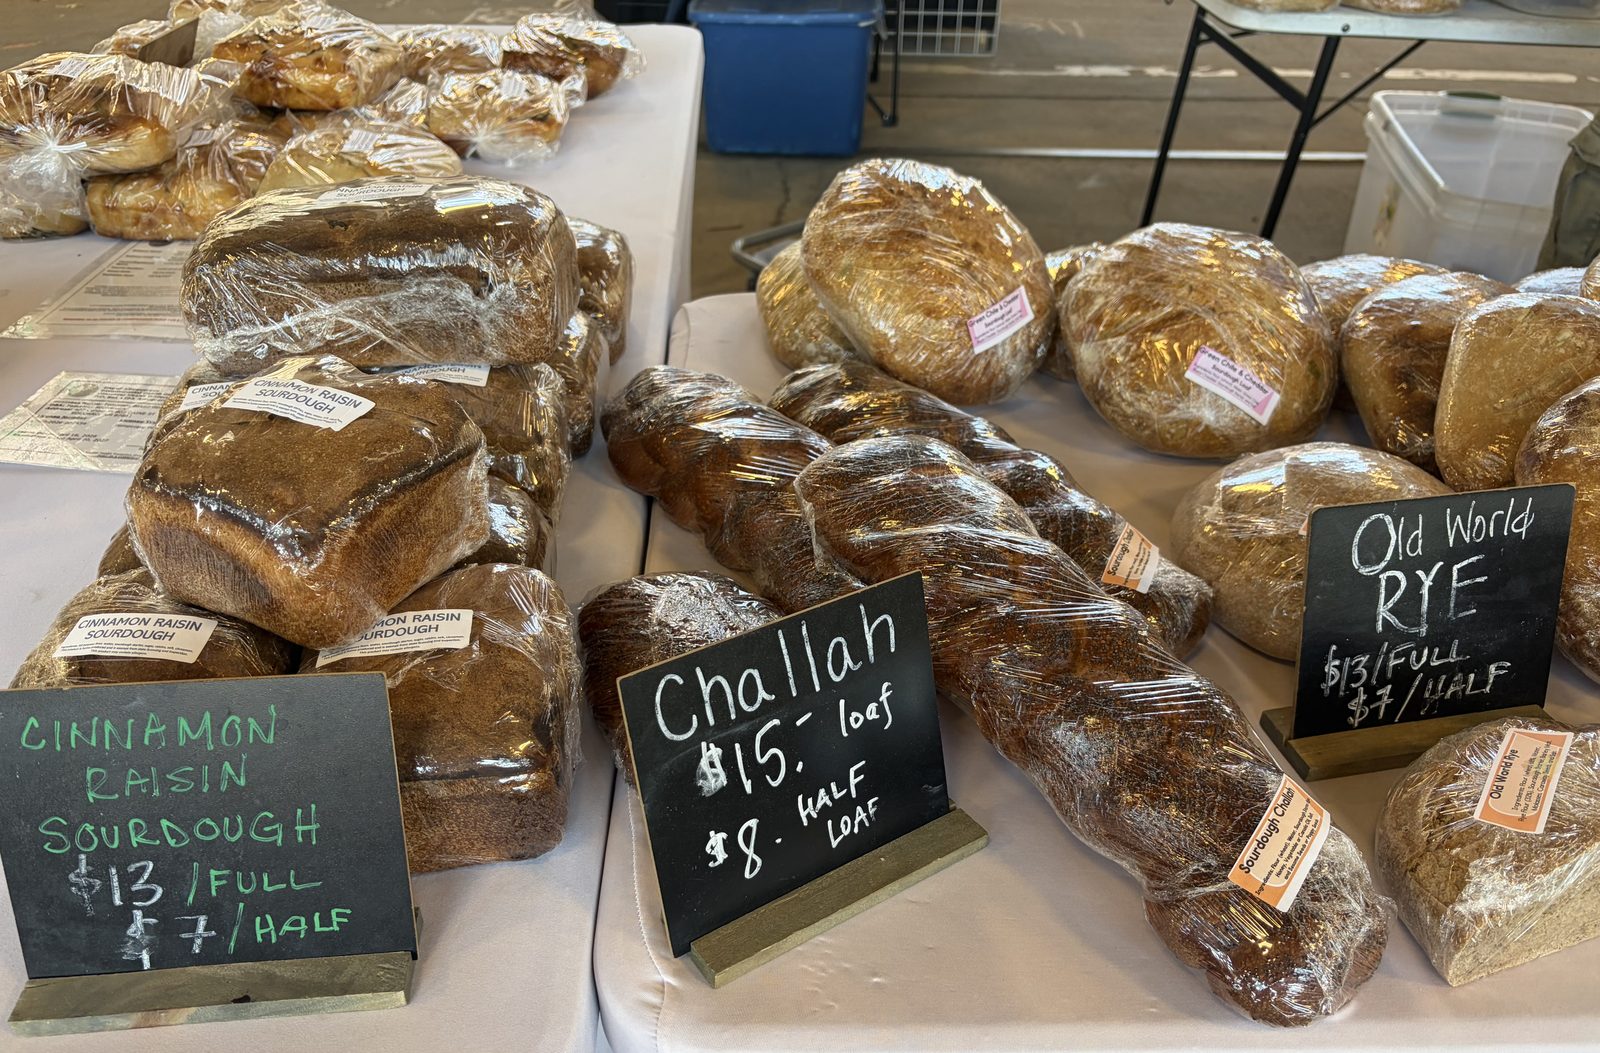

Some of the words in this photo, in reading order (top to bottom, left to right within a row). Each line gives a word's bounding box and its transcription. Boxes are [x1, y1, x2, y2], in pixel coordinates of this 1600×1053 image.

[1200, 346, 1220, 362] Green
[1220, 359, 1237, 372] Chile
[1238, 369, 1244, 377] &
[1244, 374, 1269, 394] Cheddar
[1211, 364, 1239, 383] Sourdough
[254, 379, 318, 395] CINNAMON
[318, 389, 362, 409] RAISIN
[255, 388, 336, 415] SOURDOUGH
[1352, 513, 1423, 576] Old
[1446, 497, 1535, 547] World
[1107, 543, 1130, 576] Sourdough
[1376, 554, 1488, 637] RYE
[78, 616, 151, 630] CINNAMON
[153, 618, 203, 632] RAISIN
[85, 629, 175, 642] SOURDOUGH
[412, 612, 461, 623] RAISIN
[655, 603, 896, 742] Challah
[20, 703, 277, 752] CINNAMON
[840, 681, 892, 738] loaf
[1495, 760, 1513, 783] World
[1503, 748, 1520, 761] Rye
[85, 752, 248, 803] RAISIN
[797, 760, 866, 827] HALF
[1490, 784, 1504, 799] Old
[38, 804, 321, 854] SOURDOUGH
[827, 796, 880, 849] LOAF
[1239, 818, 1279, 874] Sourdough
[1274, 787, 1296, 817] Challah
[1270, 857, 1281, 870] Flour
